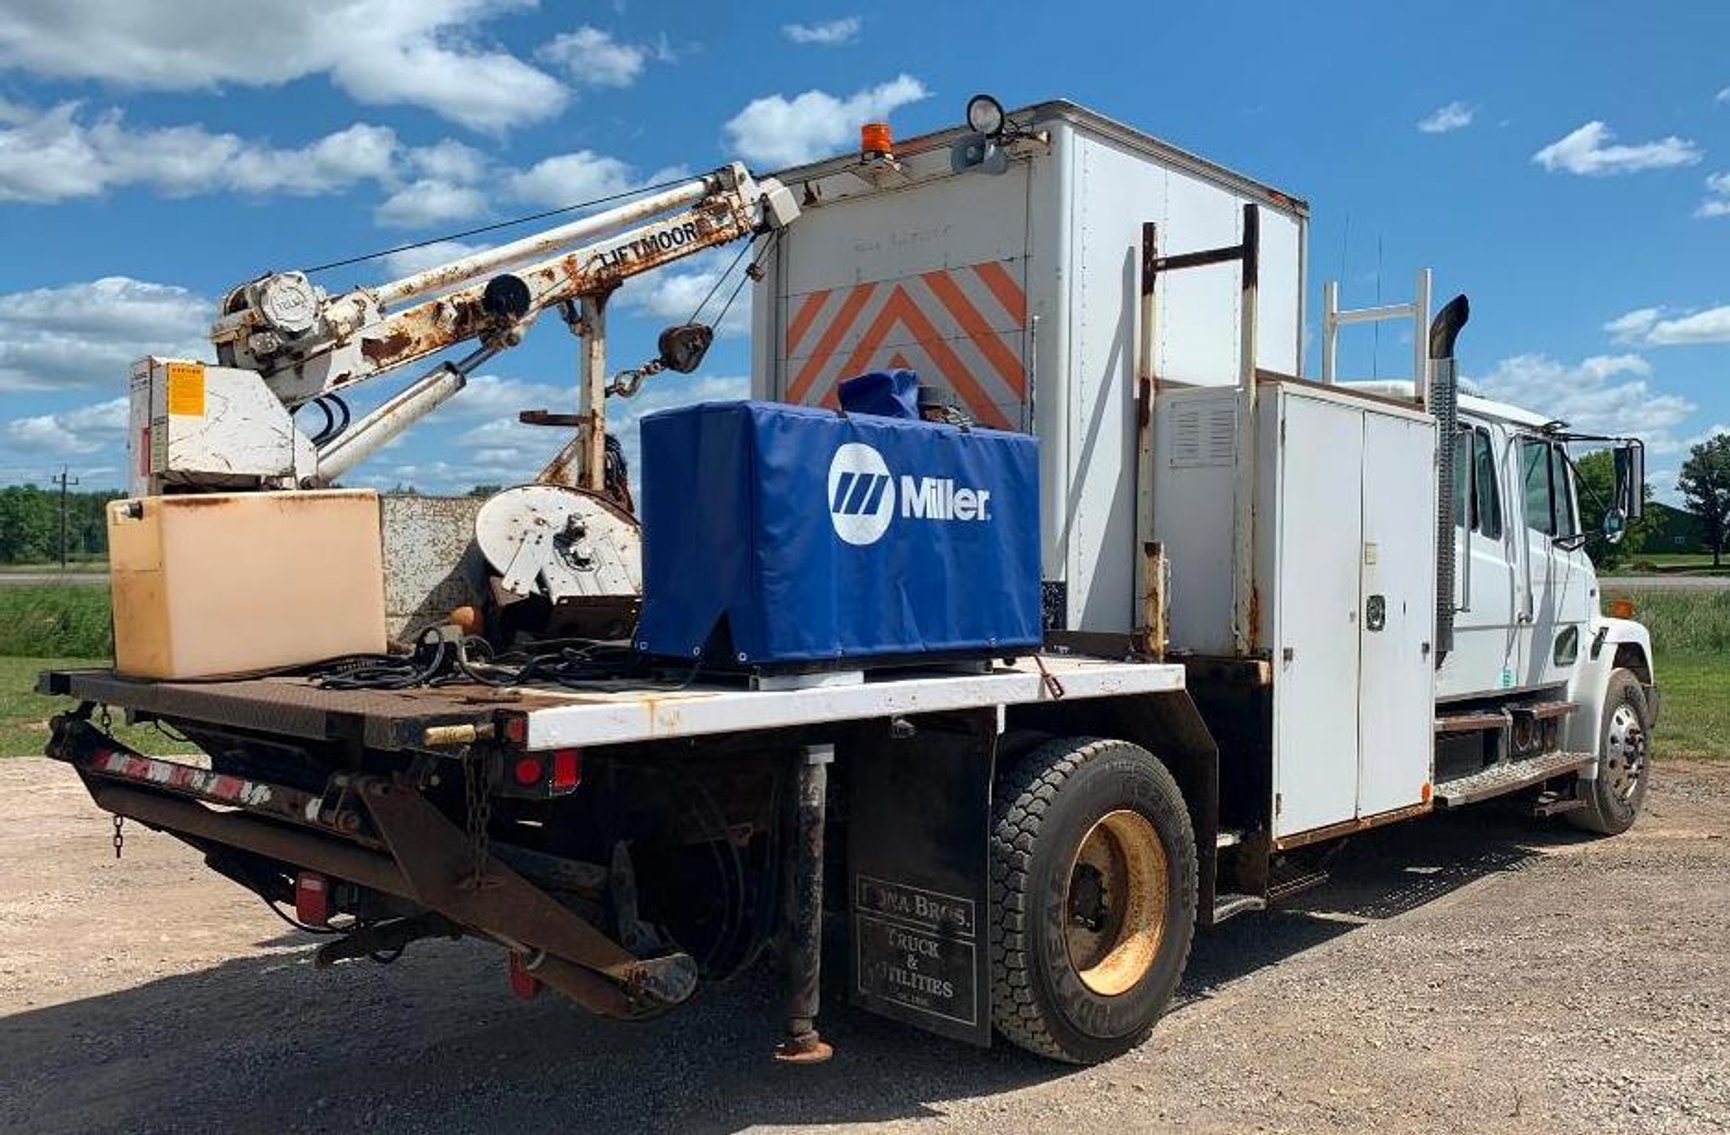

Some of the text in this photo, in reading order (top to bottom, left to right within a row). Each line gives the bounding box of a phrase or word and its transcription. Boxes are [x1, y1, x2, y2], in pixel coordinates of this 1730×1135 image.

[599, 222, 697, 267] LIFTMOOR
[901, 474, 990, 521] Miller
[888, 927, 940, 959] TRUCK
[907, 954, 919, 970] &
